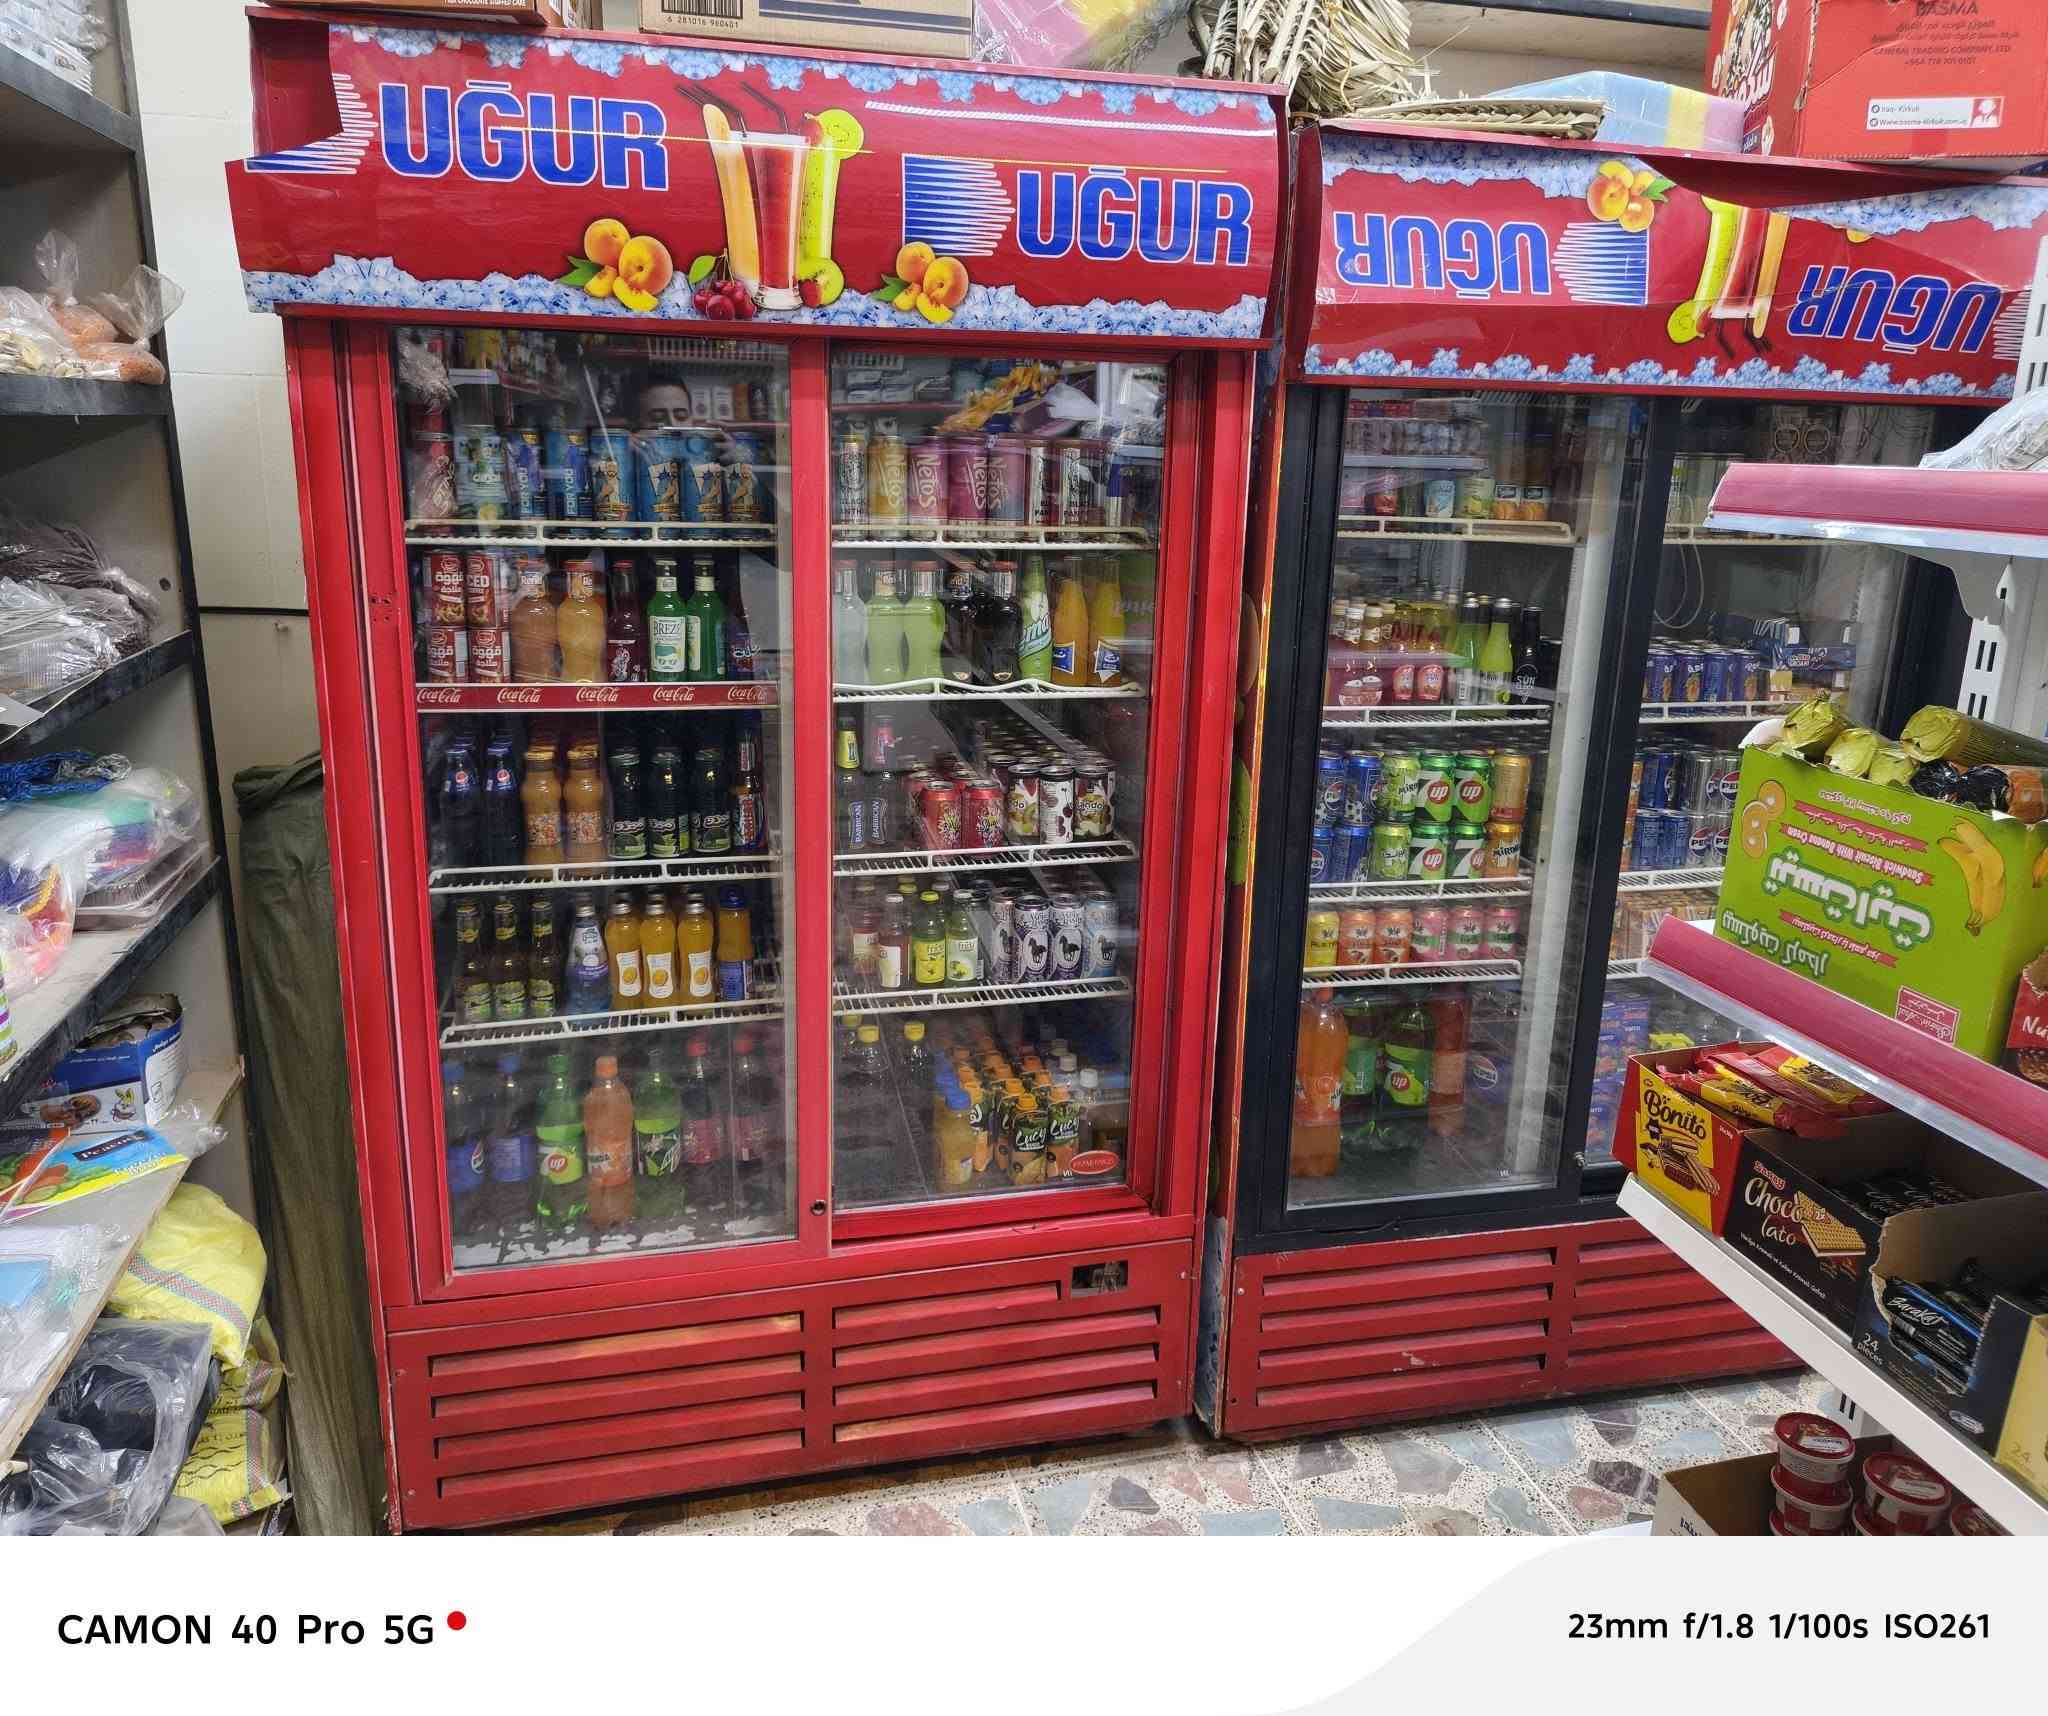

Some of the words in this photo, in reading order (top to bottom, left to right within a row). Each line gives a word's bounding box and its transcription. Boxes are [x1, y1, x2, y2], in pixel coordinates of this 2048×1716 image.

[1854, 850, 1882, 871] Biscuit
[1884, 860, 1924, 885] Sandwich
[1744, 1177, 1804, 1224] Choco
[1862, 1334, 1880, 1352] 24
